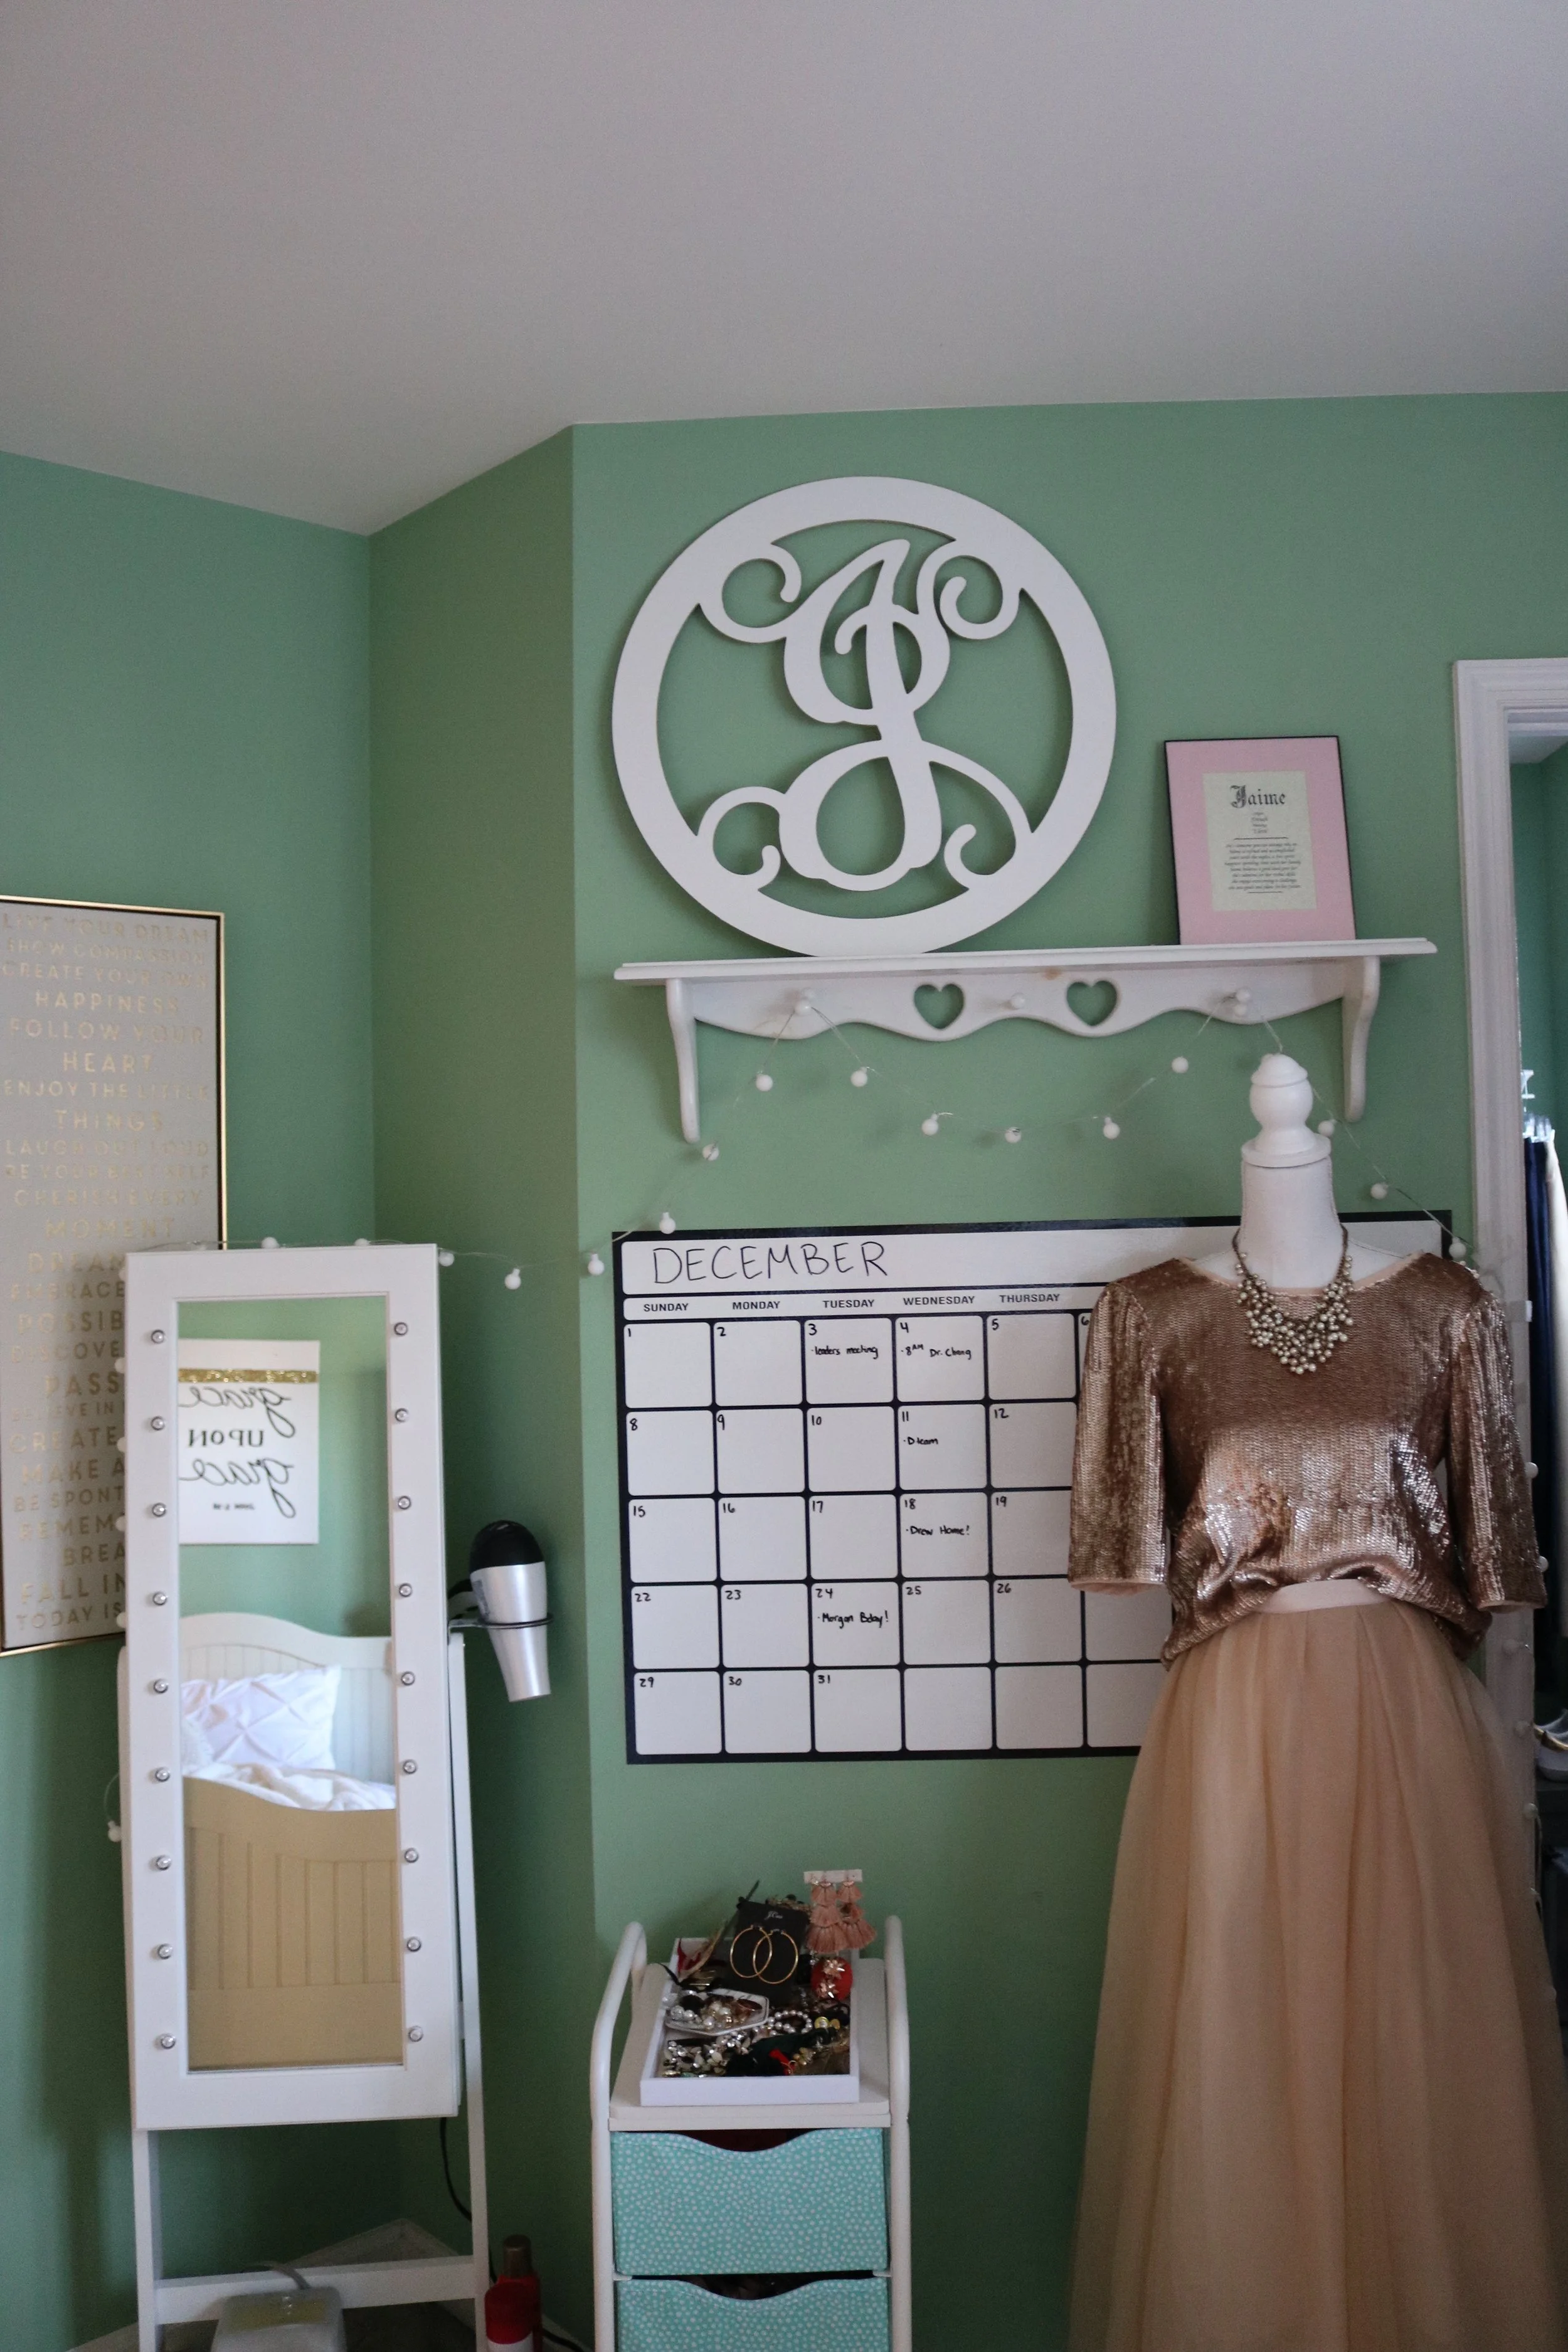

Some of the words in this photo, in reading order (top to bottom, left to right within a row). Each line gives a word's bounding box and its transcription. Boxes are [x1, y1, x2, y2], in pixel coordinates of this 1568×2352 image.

[1229, 785, 1286, 808] Jaime
[3, 961, 85, 981] CREATE
[95, 968, 151, 986] YOUR
[35, 989, 179, 1015] HAPPINESS
[9, 1017, 121, 1041] FOLLOW
[134, 1025, 203, 1043] YOUR
[63, 1049, 153, 1073] HEART
[4, 1079, 78, 1096] ENJOY
[90, 1081, 128, 1098] THE
[137, 1084, 208, 1100] LITTLE
[55, 1109, 163, 1131] THINGS
[5, 1138, 83, 1155] LAUGH
[14, 1189, 119, 1207] CHERISH
[45, 1218, 175, 1241] MOMENT
[653, 1242, 887, 1284] DECEMBER
[11, 1281, 125, 1301] EMBRACE
[644, 1303, 689, 1312] SUNDAY
[732, 1301, 780, 1310] MONDAY
[822, 1299, 874, 1308] TUESDAY
[903, 1296, 975, 1306] WEDNESDAY
[999, 1293, 1060, 1303] THURSDAY
[808, 1323, 817, 1336] 3
[899, 1322, 909, 1333] 4
[992, 1318, 1000, 1331] 5
[716, 1327, 726, 1337] 2
[815, 1345, 841, 1355] leaders
[846, 1344, 879, 1360] meeting
[930, 1348, 943, 1358] Dr.
[96, 1401, 114, 1414] IN
[993, 1407, 1009, 1419] 12
[716, 1414, 725, 1431] 9
[811, 1414, 822, 1426] 10
[902, 1411, 909, 1422] 11
[629, 1417, 638, 1431] 8
[9, 1426, 117, 1453] CREATE
[23, 1459, 98, 1485] MAKE
[13, 1495, 39, 1512] BE
[812, 1500, 824, 1513] 17
[904, 1498, 916, 1510] 18
[995, 1495, 1007, 1507] 19
[633, 1505, 646, 1518] 15
[723, 1503, 736, 1513] 16
[20, 1513, 124, 1540] REMEM
[909, 1525, 933, 1536] Drew
[940, 1525, 970, 1536] Home!
[21, 1576, 89, 1604] FALL
[724, 1589, 741, 1600] 23
[815, 1587, 834, 1599] 24
[906, 1585, 922, 1596] 25
[997, 1582, 1012, 1594] 26
[634, 1592, 652, 1602] 22
[16, 1606, 93, 1630] TODAY
[822, 1613, 854, 1629] Morgan
[859, 1610, 888, 1628] Bday!
[639, 1677, 655, 1688] 29
[728, 1676, 743, 1687] 30
[817, 1675, 830, 1684] 31
